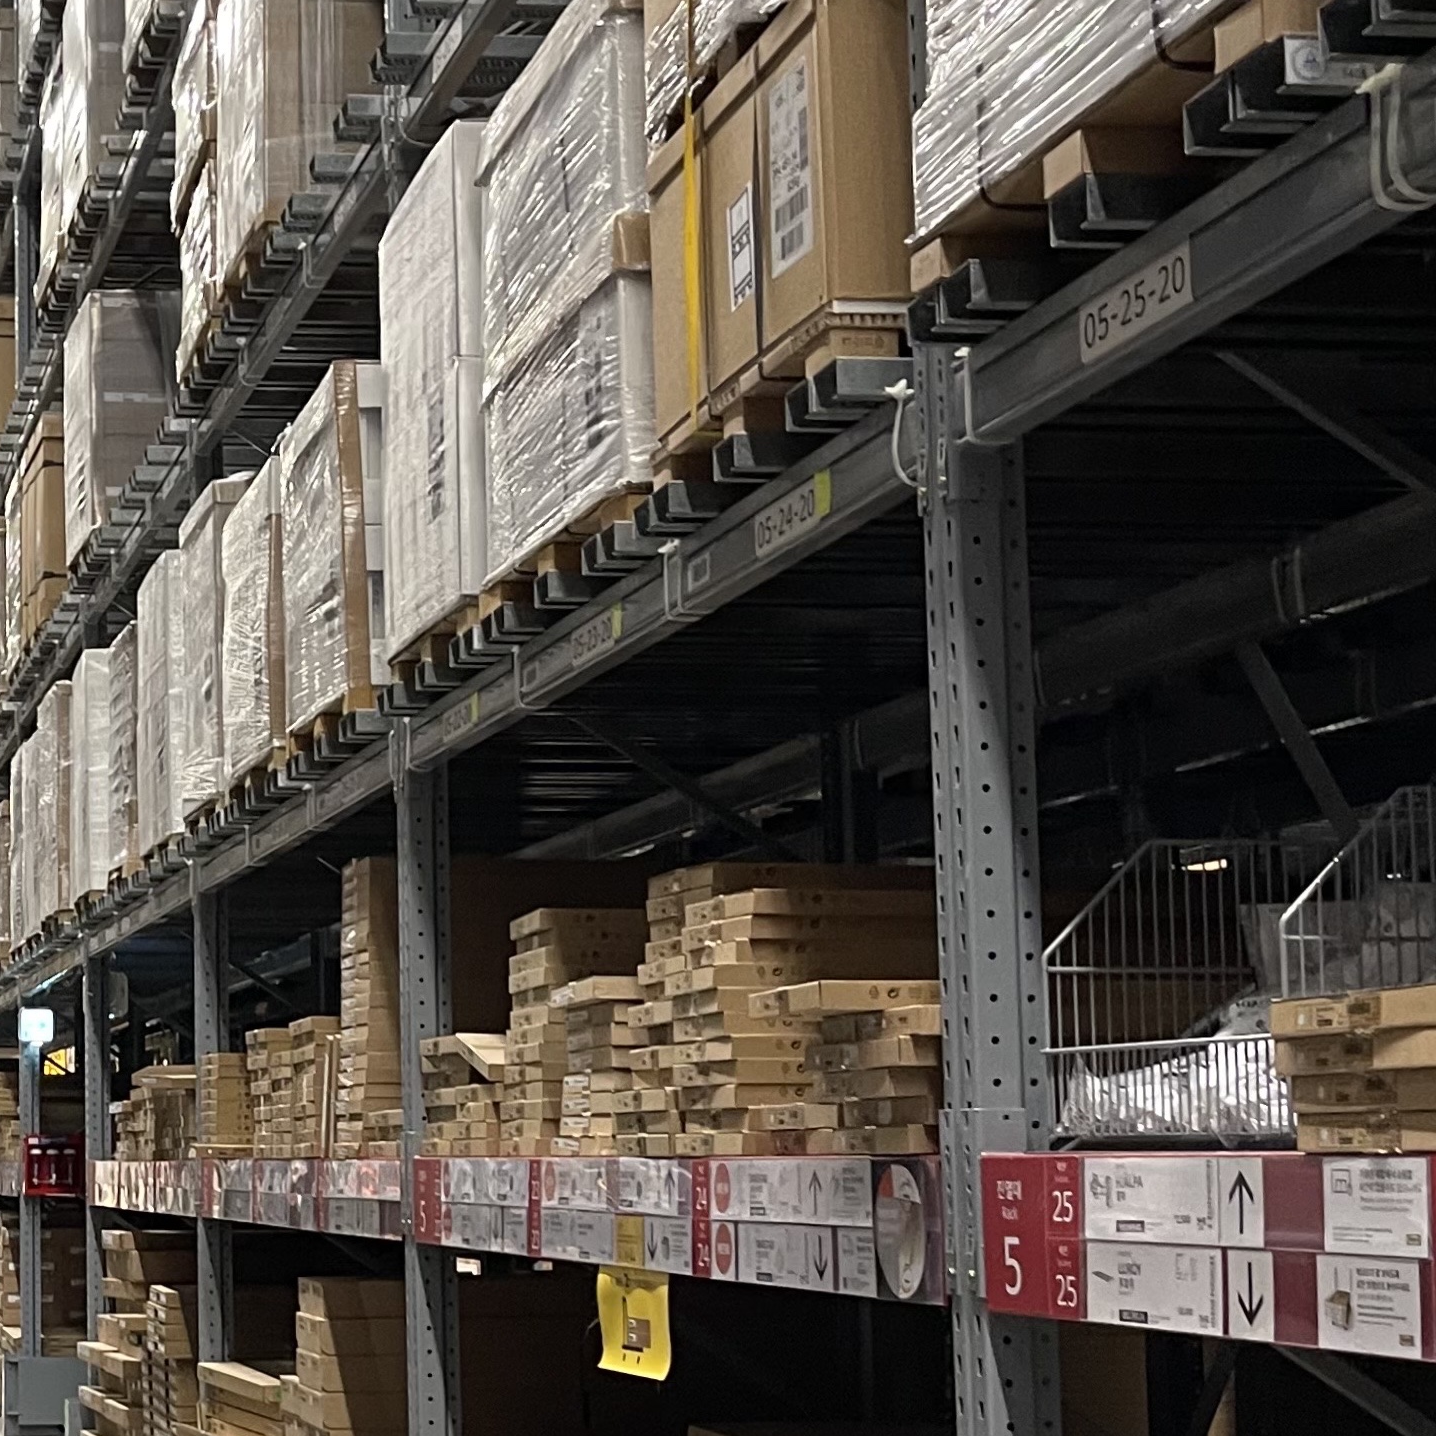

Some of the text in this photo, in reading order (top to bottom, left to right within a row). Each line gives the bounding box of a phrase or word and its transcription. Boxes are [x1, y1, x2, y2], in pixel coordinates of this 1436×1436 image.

[1085, 256, 1185, 348] 05-25-20
[757, 489, 814, 549] 05-24-20
[1052, 1190, 1074, 1223] 25
[1004, 1236, 1023, 1296] 5
[1055, 1274, 1078, 1308] 25
